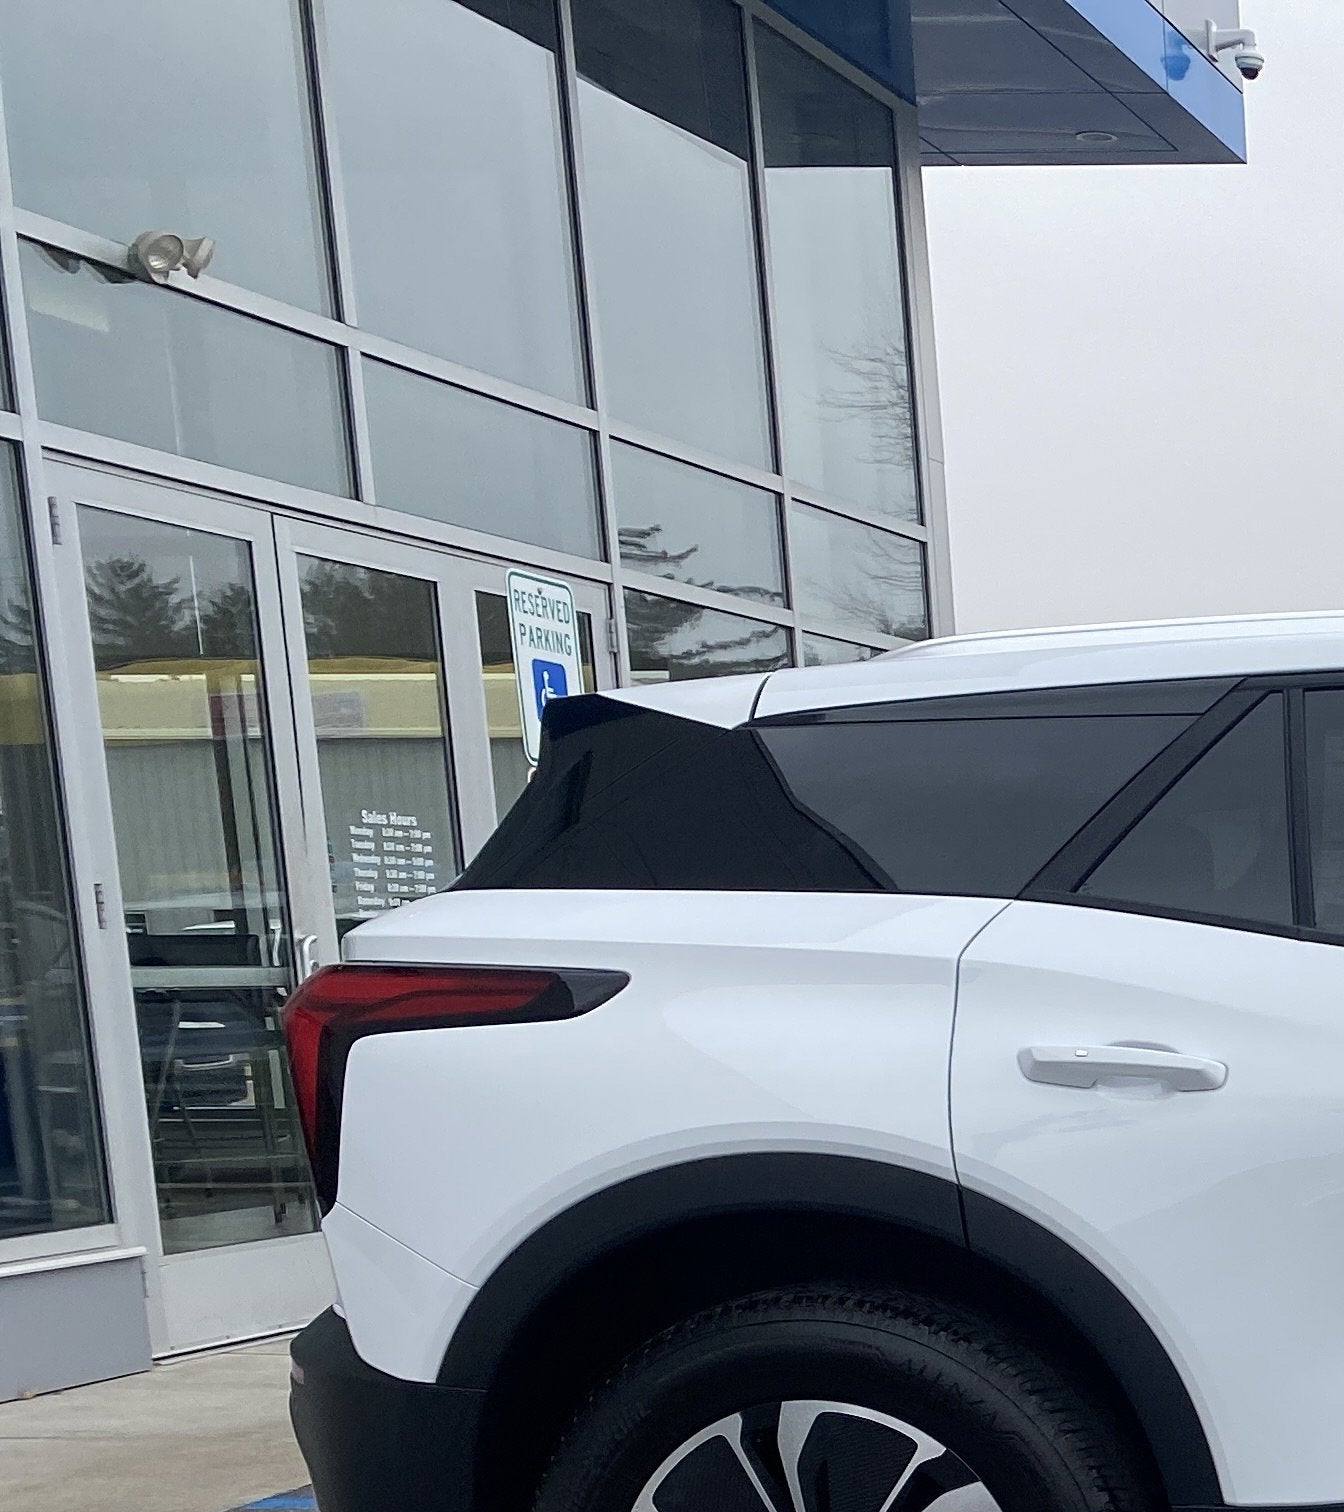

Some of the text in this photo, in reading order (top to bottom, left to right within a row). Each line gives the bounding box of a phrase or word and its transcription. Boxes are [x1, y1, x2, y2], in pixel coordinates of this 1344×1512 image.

[513, 589, 570, 624] RESERVED
[519, 623, 572, 656] PARKING
[361, 809, 418, 827] Sales Hours
